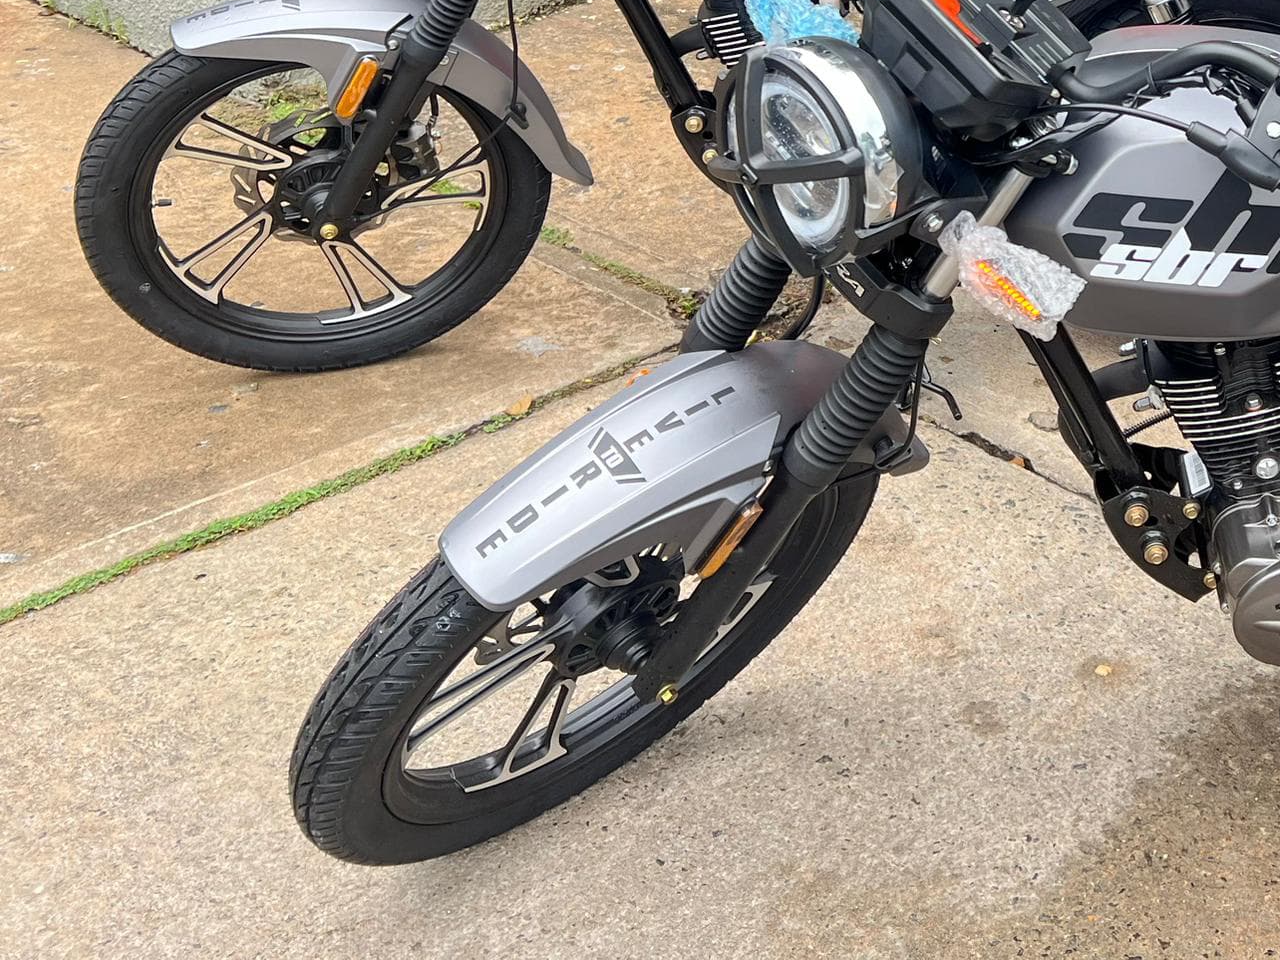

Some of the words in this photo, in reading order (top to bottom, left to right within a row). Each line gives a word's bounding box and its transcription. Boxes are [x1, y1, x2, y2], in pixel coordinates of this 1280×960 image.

[622, 385, 736, 454] LIVE
[601, 445, 625, 469] TO
[474, 460, 602, 560] RIDE
